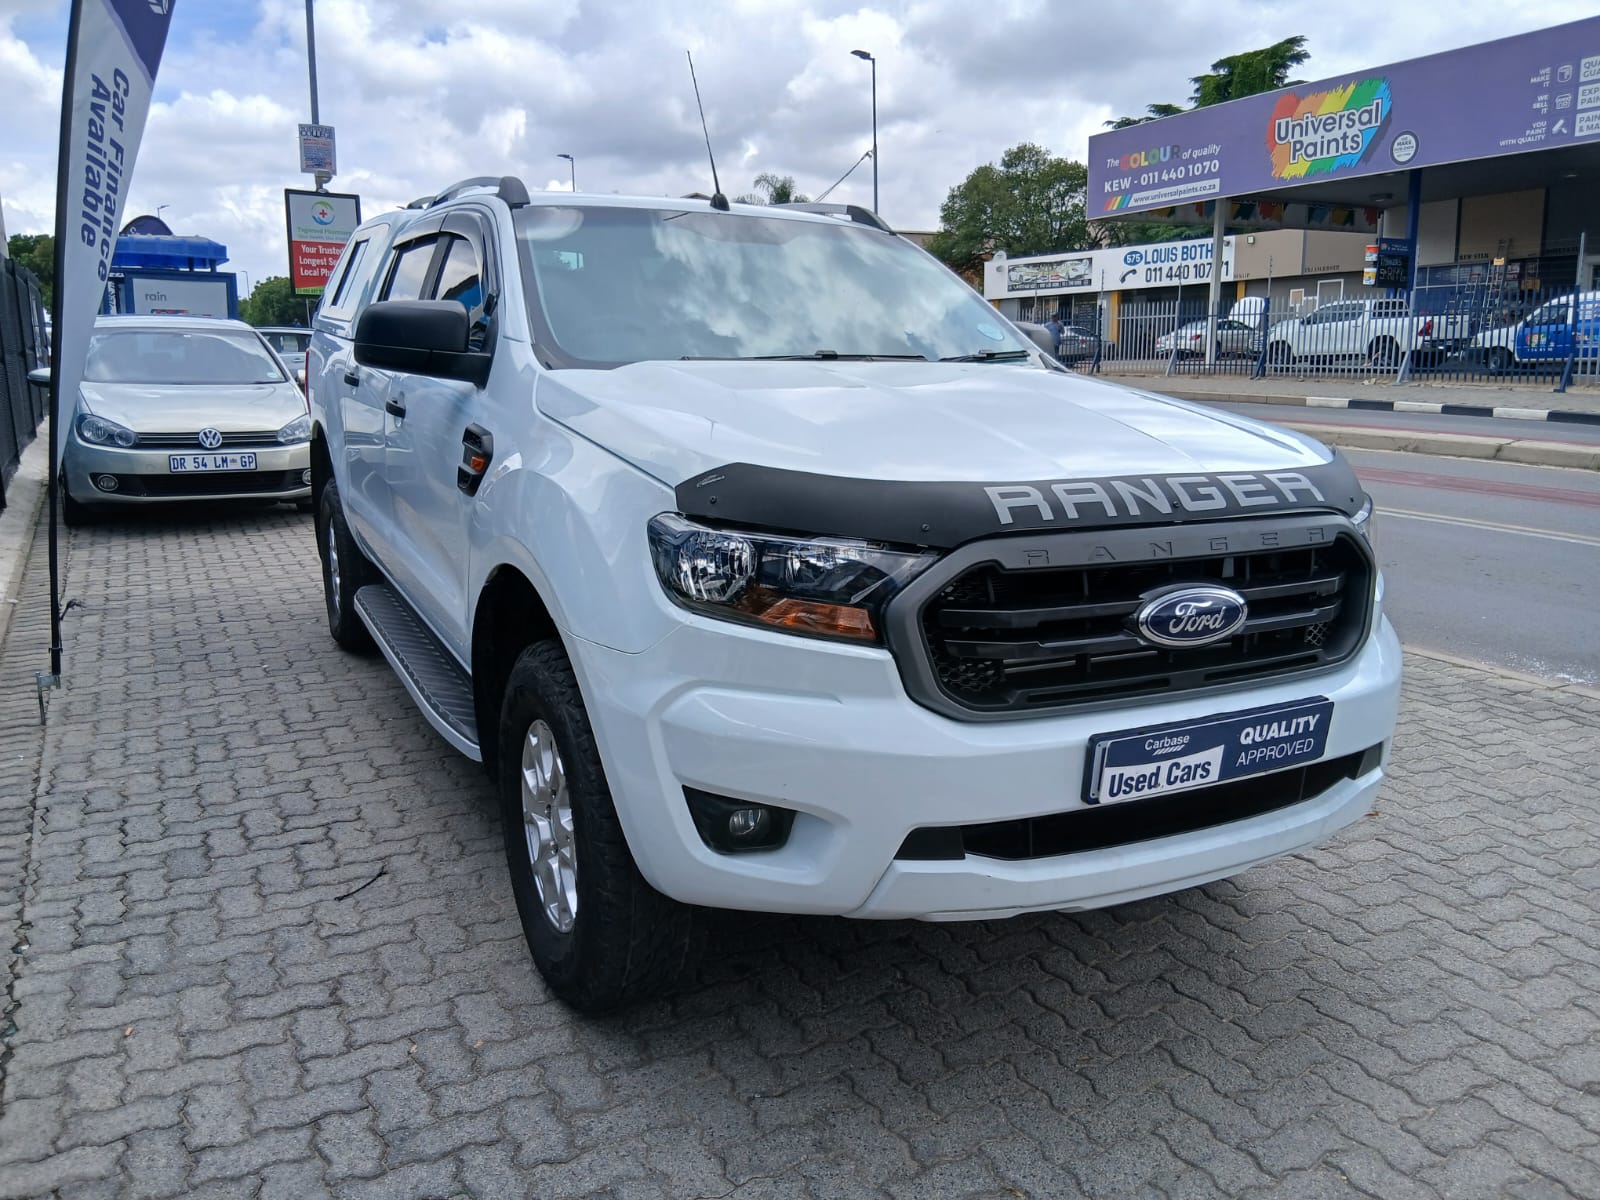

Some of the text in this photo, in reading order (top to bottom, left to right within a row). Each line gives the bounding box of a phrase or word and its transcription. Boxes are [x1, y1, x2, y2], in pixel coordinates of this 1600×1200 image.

[112, 67, 130, 133] Car
[1276, 101, 1381, 142] Universal
[1525, 127, 1546, 136] PAINT
[1291, 131, 1361, 162] Paints
[1517, 135, 1545, 145] QUALITY
[81, 73, 111, 248] Available
[1106, 144, 1221, 170] The COLOUR of quality
[1104, 176, 1132, 193] KEW
[1141, 171, 1158, 186] 011
[1161, 166, 1185, 181] 440
[1188, 159, 1220, 177] 1070
[1133, 183, 1217, 203] www.universalpaints.co.za
[97, 136, 124, 282] Finance
[299, 256, 327, 267] Longest
[301, 244, 317, 254] Your
[1144, 247, 1178, 265] LOUIS
[300, 266, 320, 276] Local
[1145, 266, 1163, 283] 011
[1166, 264, 1190, 281] 440
[145, 291, 167, 302] rain
[171, 455, 254, 470] DR 54 LM GP
[983, 471, 1326, 526] RANGER
[1022, 527, 1326, 566] RANGER
[1168, 601, 1225, 635] Ford
[1144, 713, 1321, 751] Carbase QUALITY
[1108, 738, 1314, 798] Used Cars APPROVED
